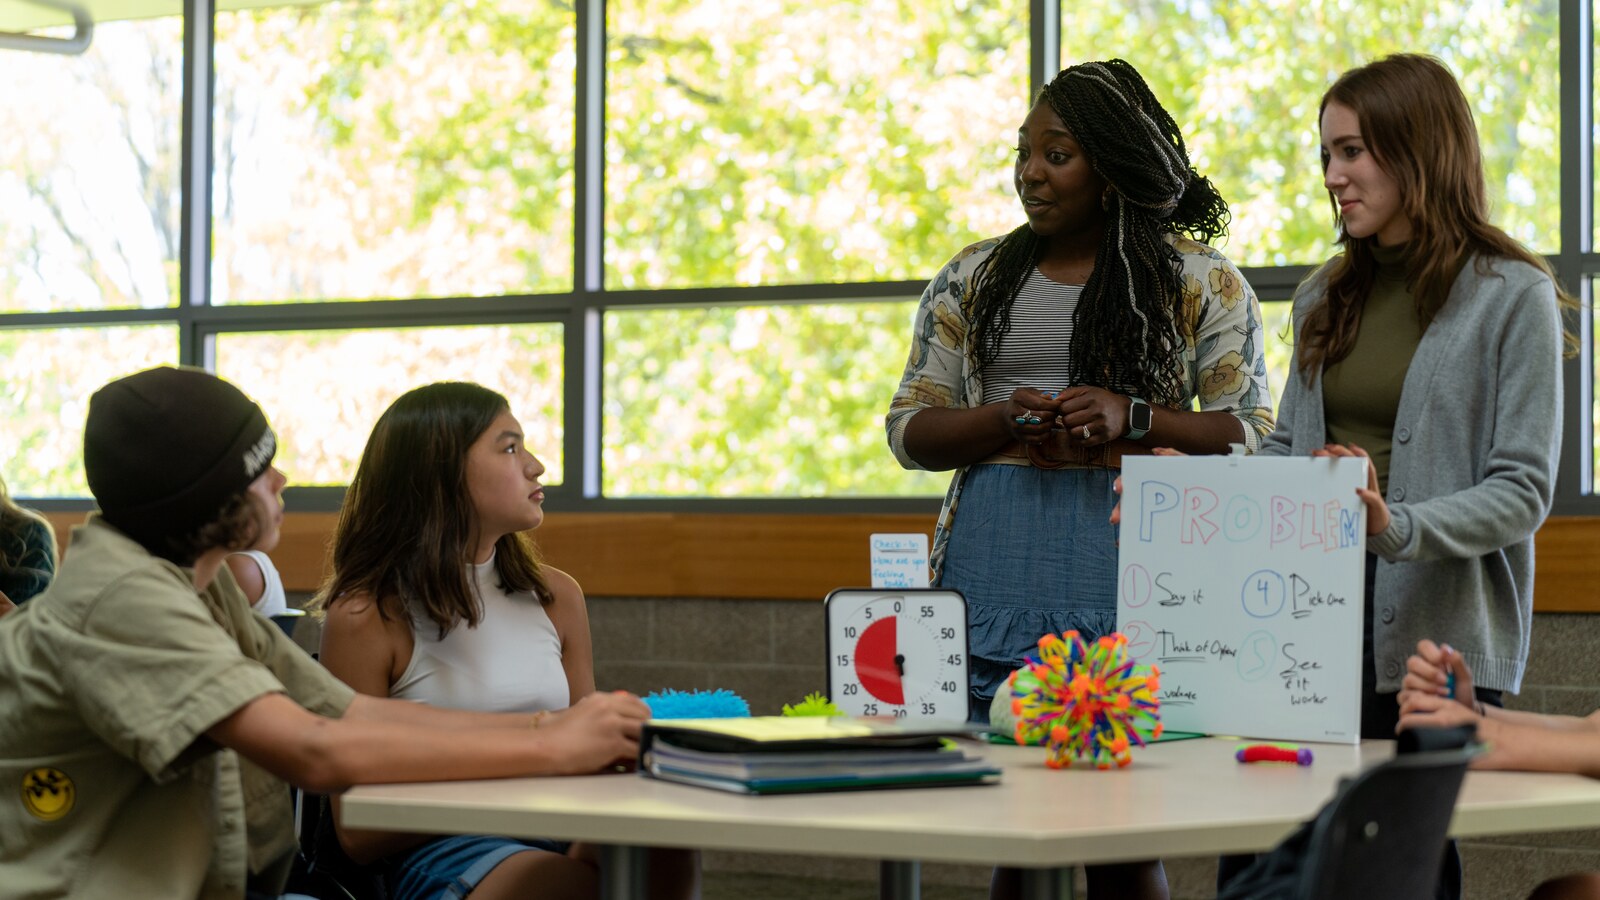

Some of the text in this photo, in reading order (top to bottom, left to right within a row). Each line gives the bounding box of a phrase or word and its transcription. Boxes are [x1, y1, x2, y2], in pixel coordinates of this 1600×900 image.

[1139, 480, 1360, 552] PROBLEM
[1155, 572, 1186, 606] Say
[1192, 588, 1204, 604] it
[1289, 573, 1324, 610] Pick
[865, 608, 872, 619] 5
[893, 602, 901, 613] 0
[921, 606, 934, 617] 55
[844, 627, 856, 638] 10
[941, 628, 955, 639] 50
[1157, 629, 1191, 657] Think
[1195, 640, 1209, 652] of
[837, 655, 849, 666] 15
[947, 654, 962, 666] 45
[1281, 642, 1322, 671] See
[843, 684, 857, 695] 20
[941, 681, 956, 692] 40
[1296, 677, 1310, 691] it
[864, 704, 878, 716] 25
[921, 703, 936, 715] 35
